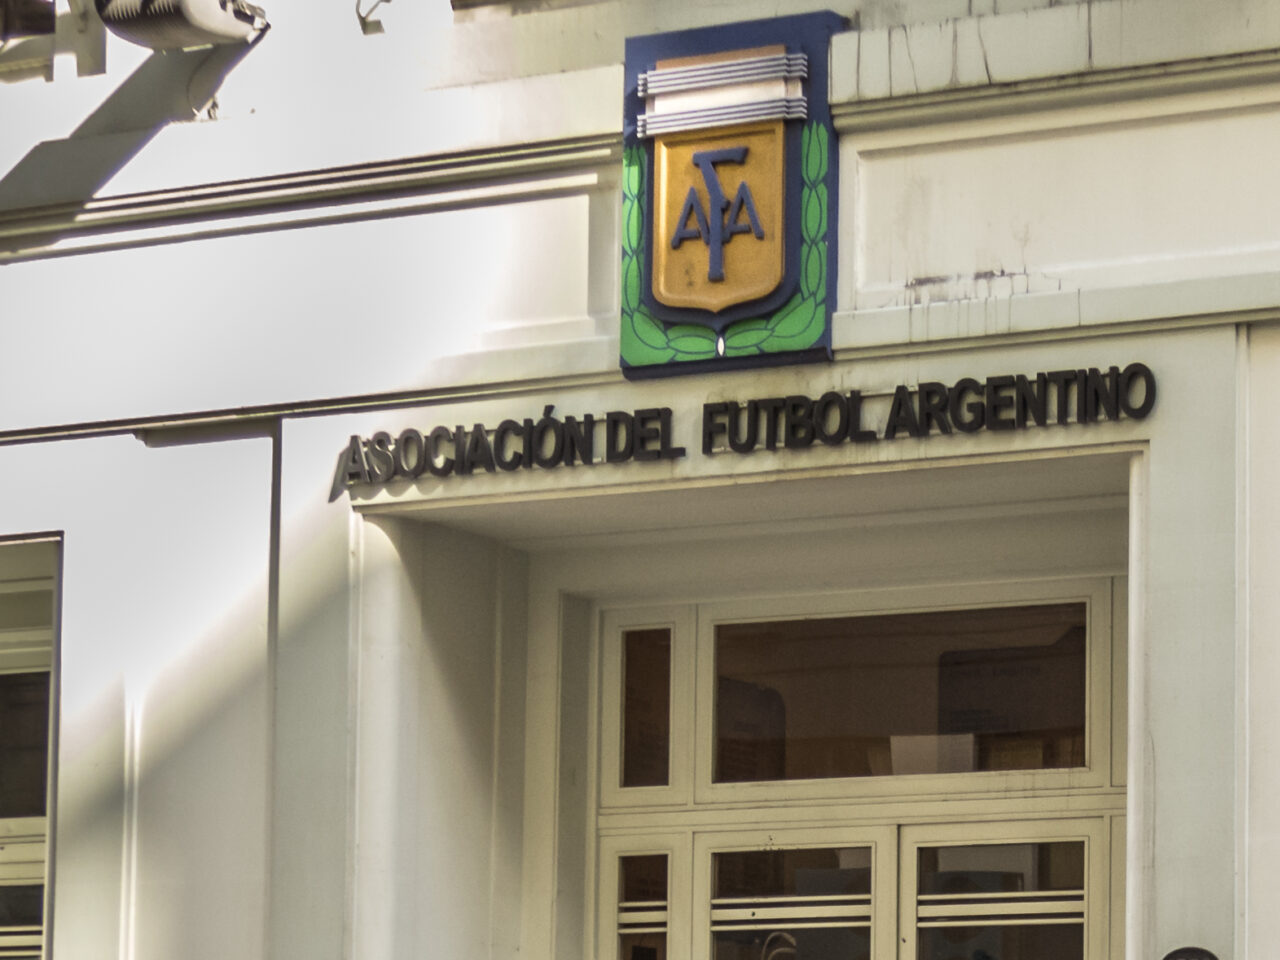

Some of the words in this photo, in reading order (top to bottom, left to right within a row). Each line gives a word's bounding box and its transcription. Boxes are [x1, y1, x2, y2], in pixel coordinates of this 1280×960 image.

[339, 404, 594, 485] ASOCIACIÓN
[605, 407, 686, 463] DEL
[702, 390, 877, 455] FUTBOL
[884, 362, 1157, 440] ARGENTINO
